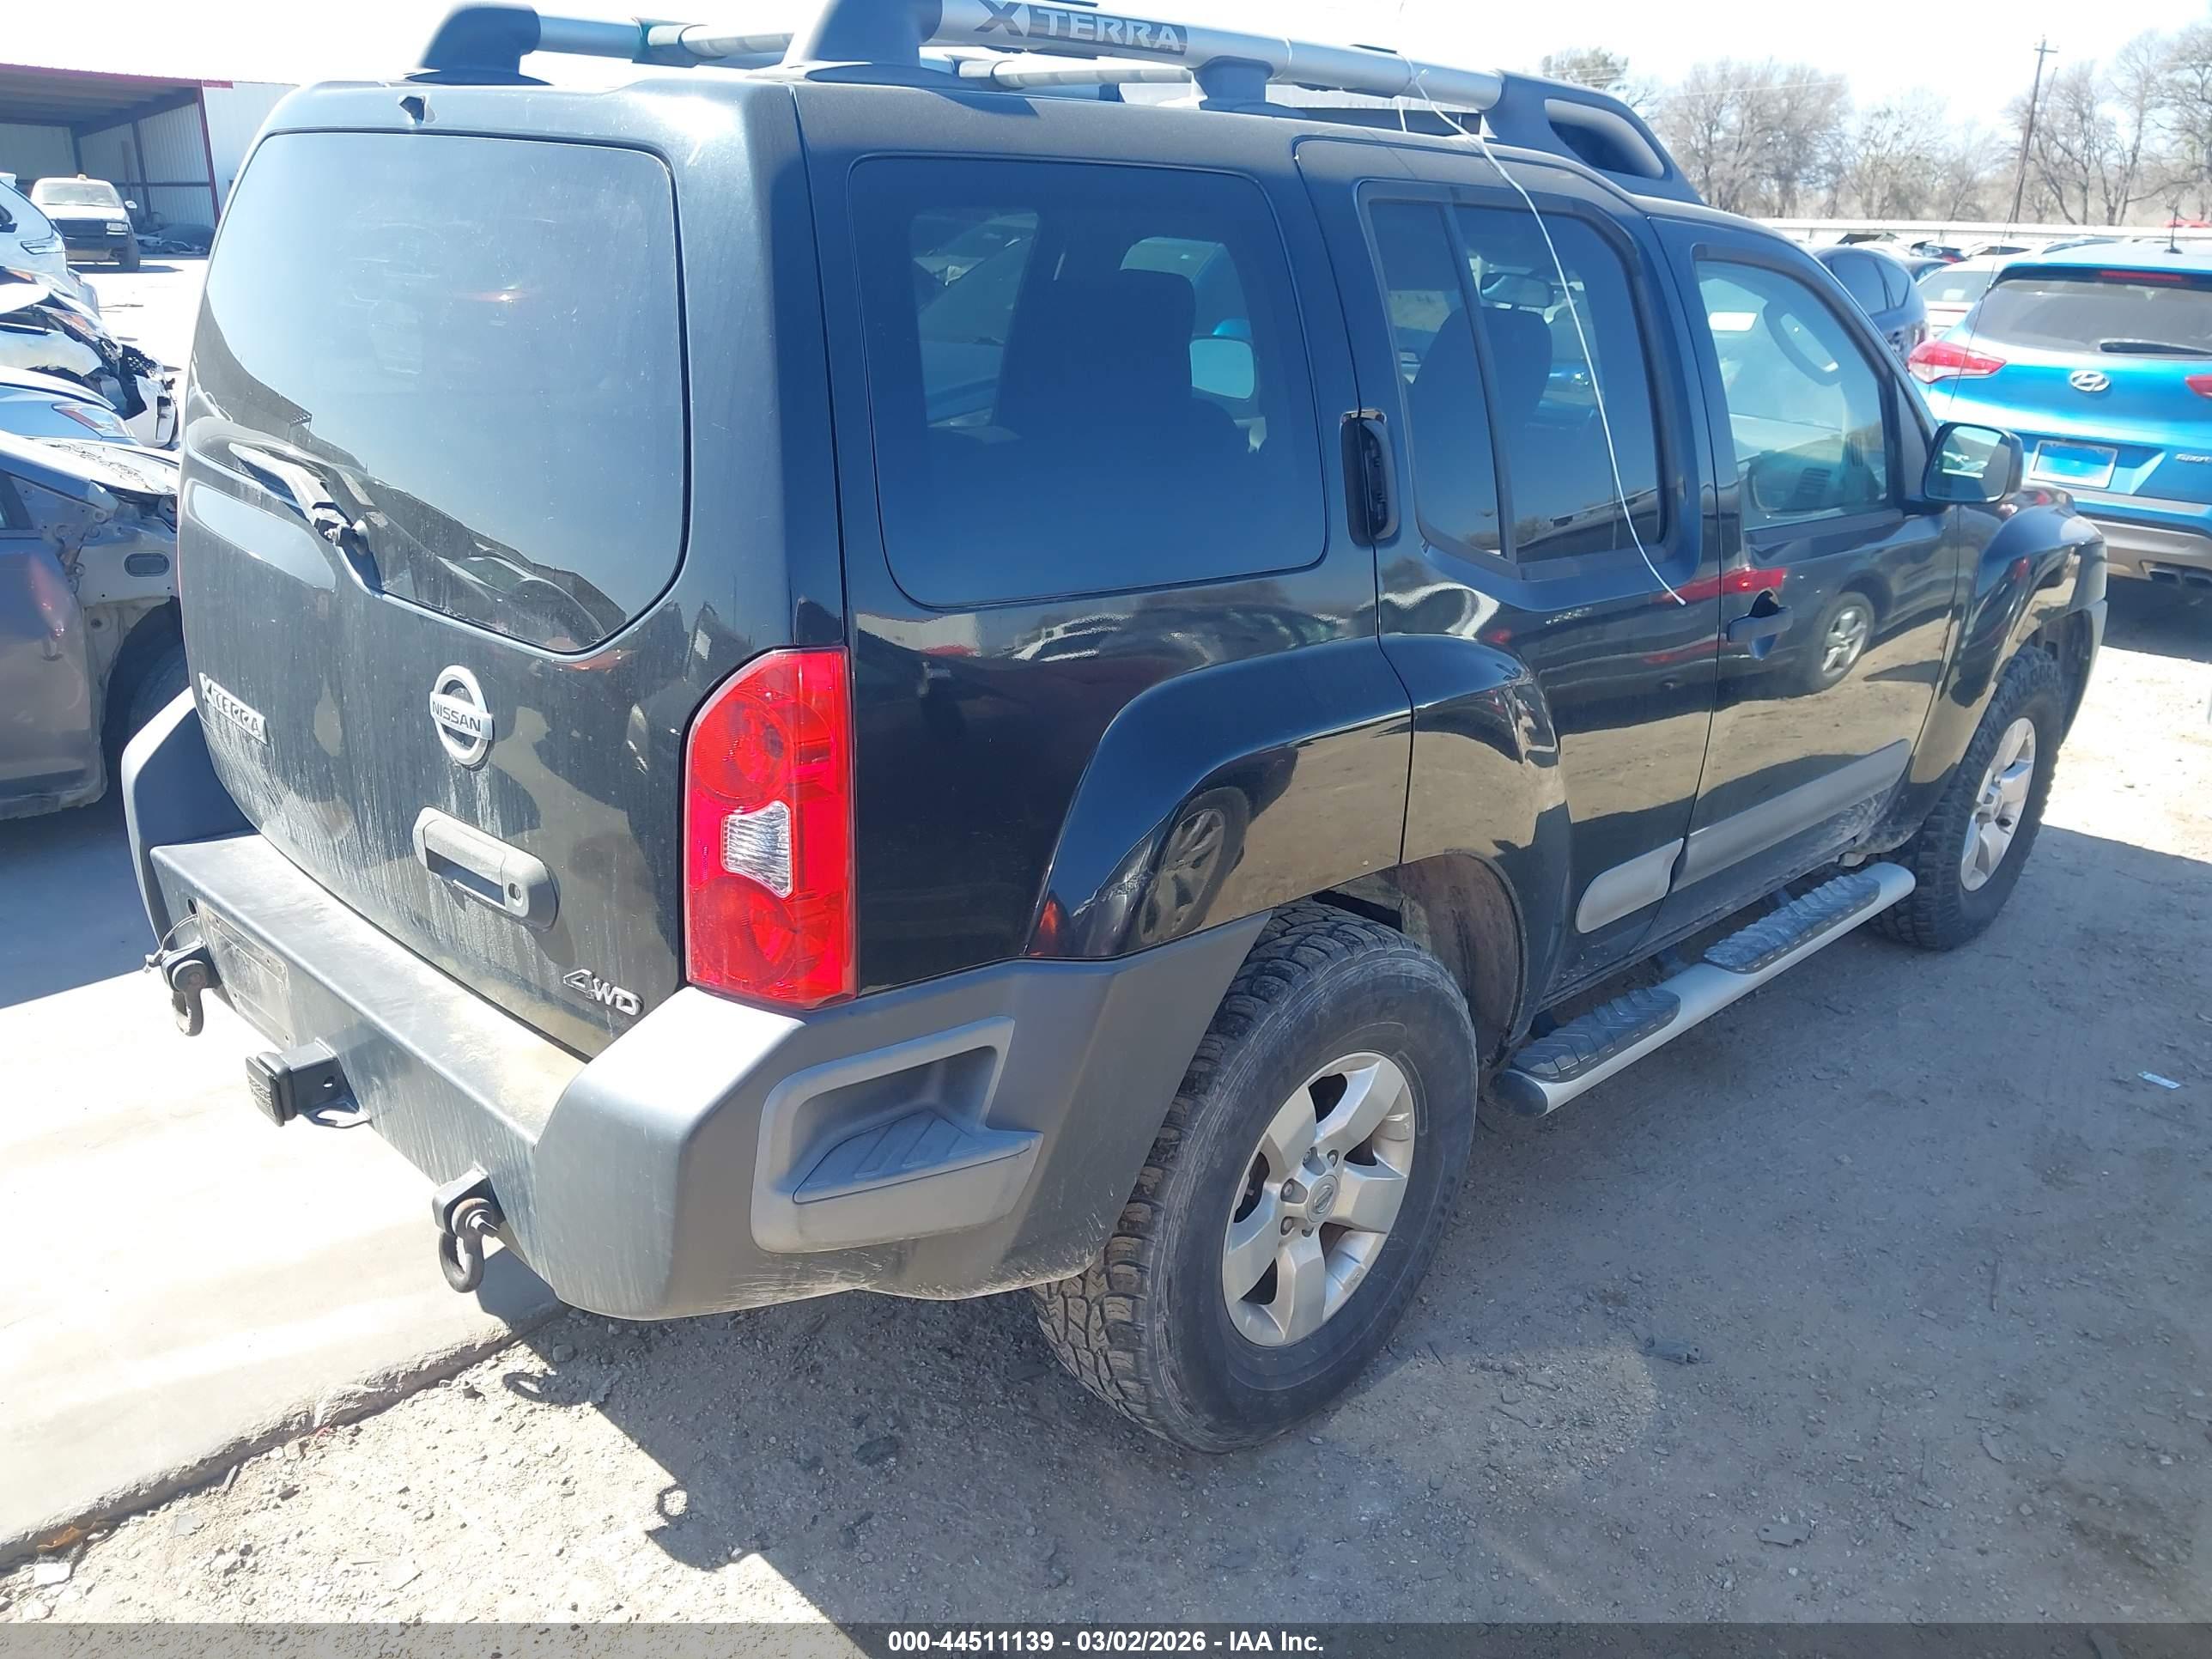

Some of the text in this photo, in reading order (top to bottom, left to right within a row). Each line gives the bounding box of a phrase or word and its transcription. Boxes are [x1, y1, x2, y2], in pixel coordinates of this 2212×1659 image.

[974, 0, 1182, 52] XTERRA
[198, 672, 264, 741] XTERRA
[432, 700, 482, 732] NISSAN
[562, 969, 642, 1016] 4WD
